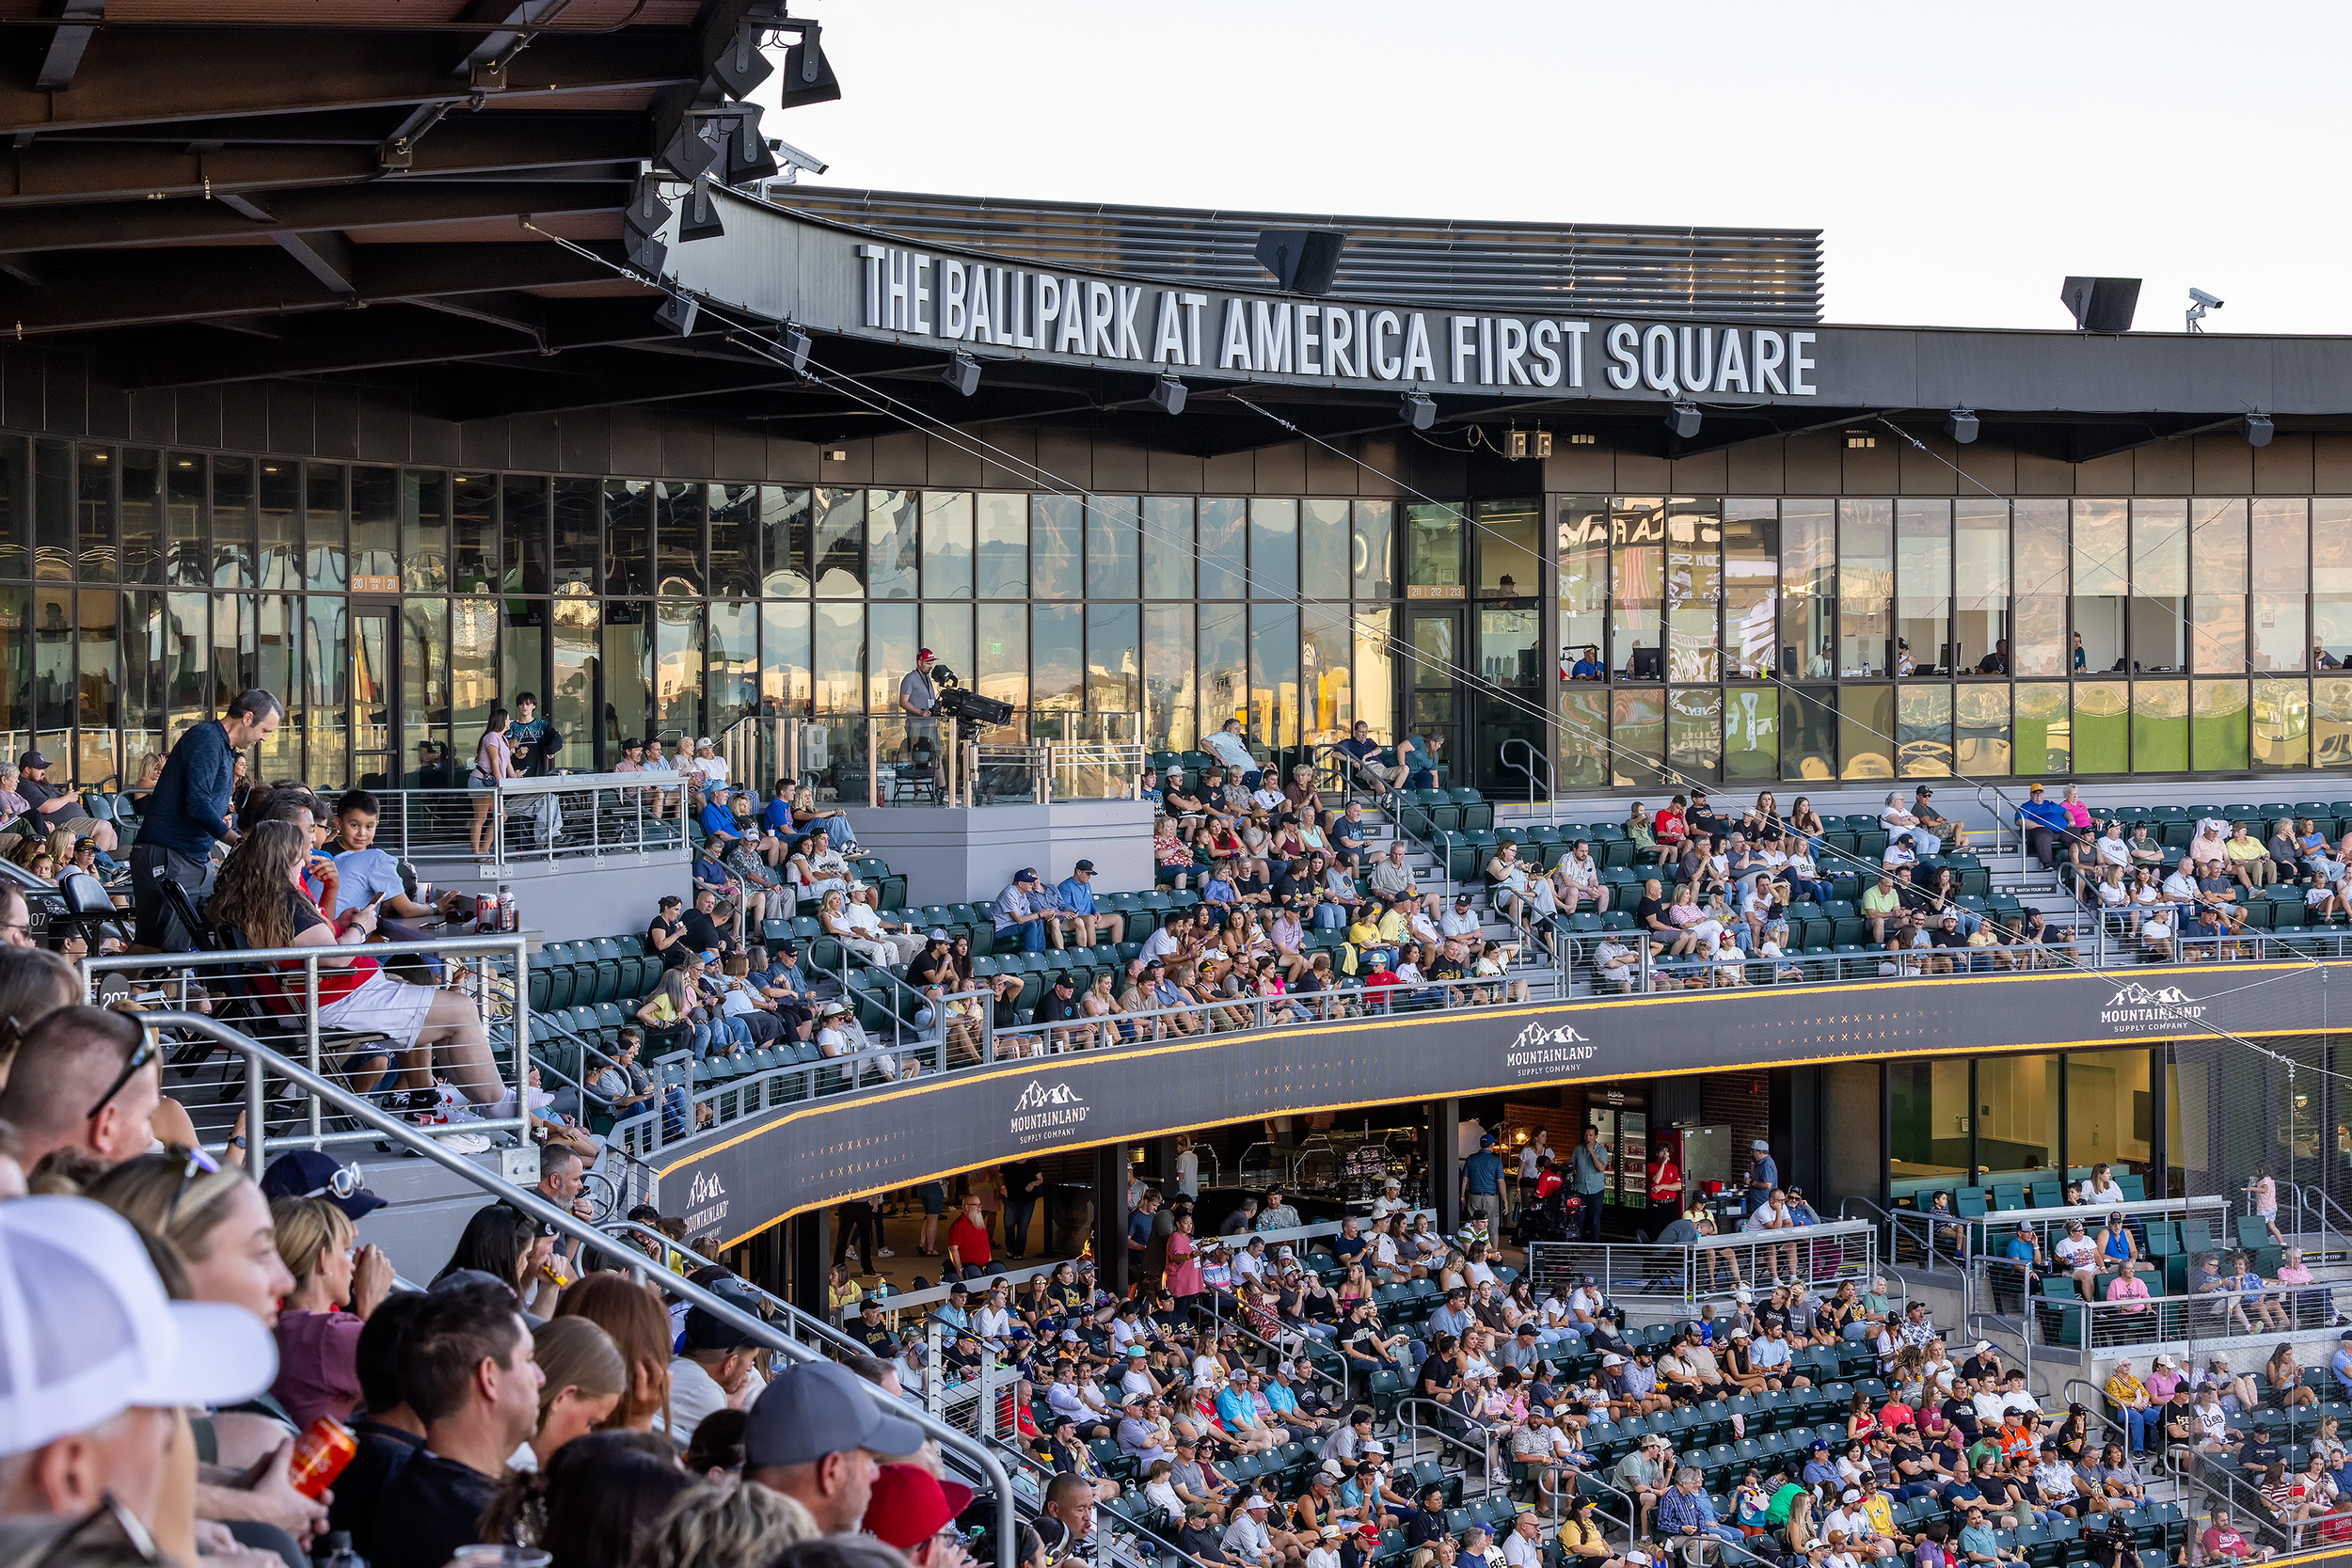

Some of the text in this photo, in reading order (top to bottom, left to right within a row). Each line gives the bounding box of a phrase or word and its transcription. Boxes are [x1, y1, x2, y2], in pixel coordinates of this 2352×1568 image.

[860, 244, 1818, 399] THE BALLPARK AT AMERICA FIRST SQUARE
[353, 578, 363, 589] 210
[387, 578, 396, 590] 211
[1412, 588, 1422, 596] 211
[1430, 588, 1441, 596] 212
[1450, 588, 1461, 597] 213
[481, 898, 498, 911] oke
[28, 912, 46, 927] 07
[2114, 1022, 2189, 1034] SUPPLY COMPANY
[1518, 1063, 1581, 1077] SUPPLY COMPANY
[1019, 1127, 1076, 1145] SUPPLY COMPANY
[2201, 1414, 2224, 1427] Bees
